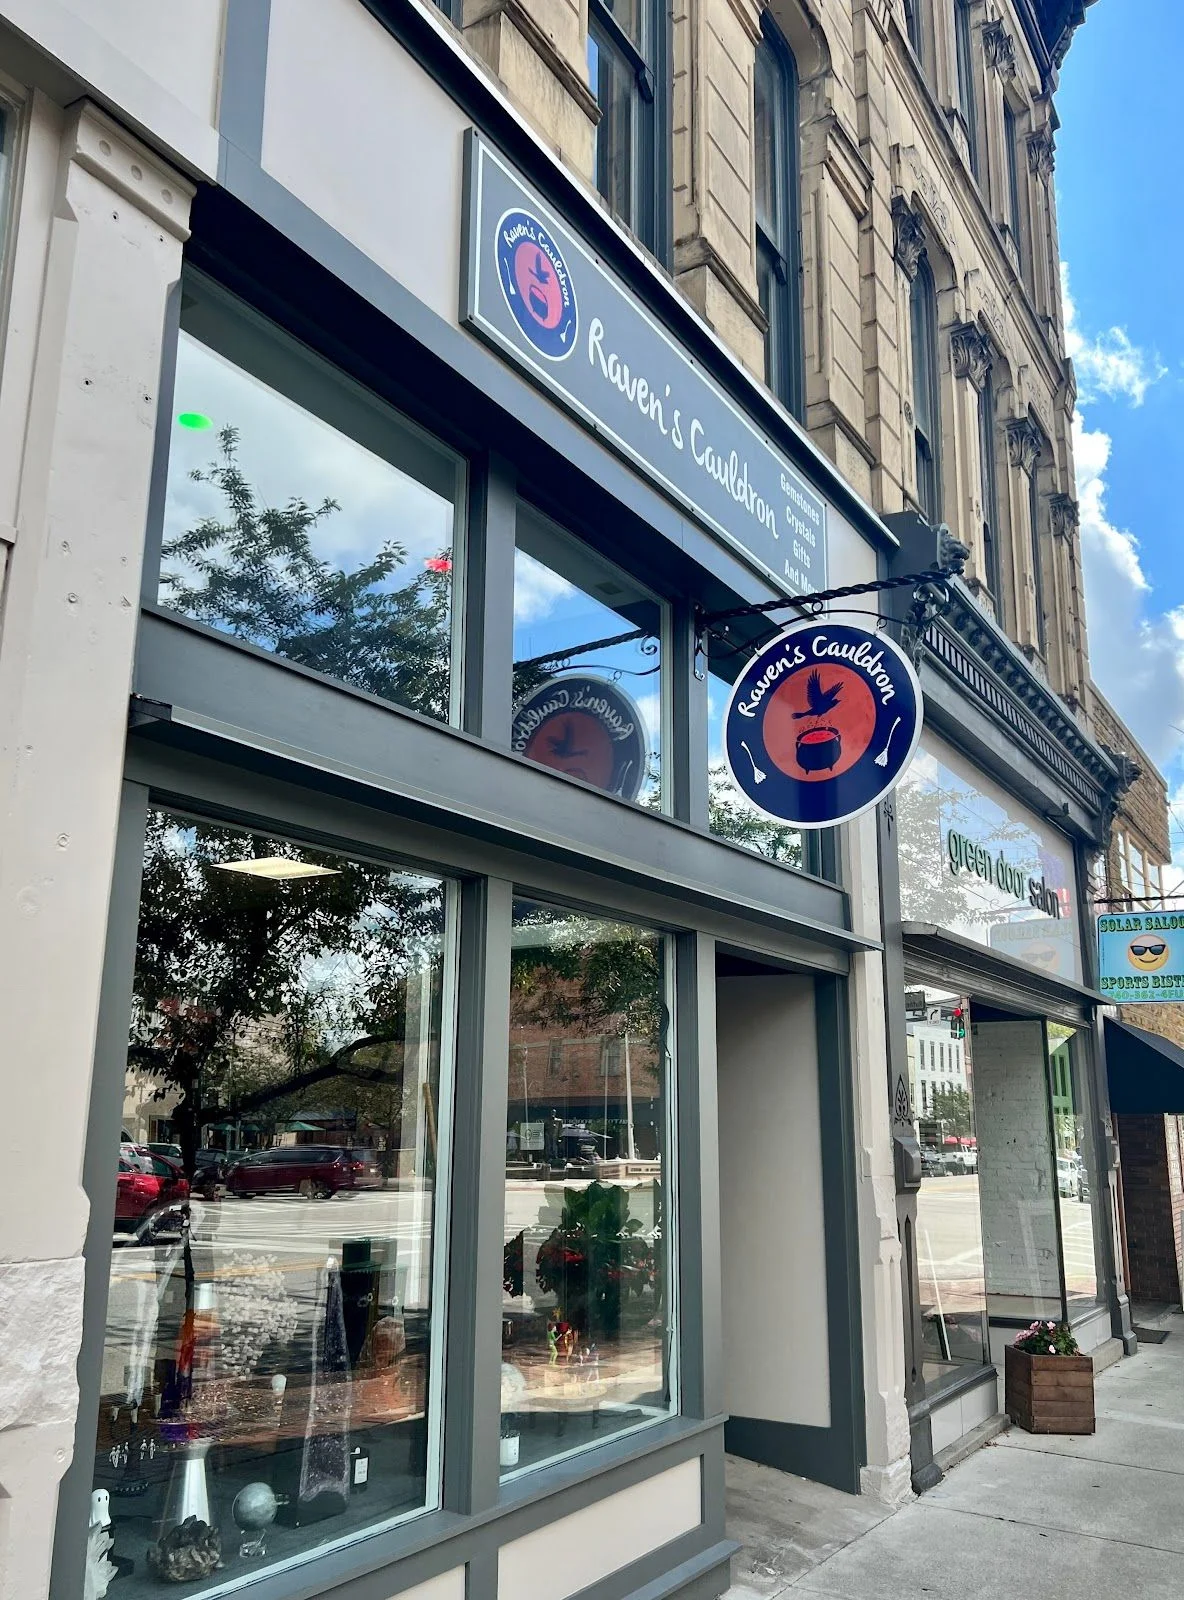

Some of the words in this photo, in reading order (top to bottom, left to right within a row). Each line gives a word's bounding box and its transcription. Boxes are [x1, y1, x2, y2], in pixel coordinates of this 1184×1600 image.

[503, 219, 536, 248] Raven's
[538, 231, 570, 308] Cauldron
[587, 317, 684, 450] Raven's
[690, 419, 779, 539] Cauldron
[780, 472, 820, 526] Gemstones
[785, 505, 816, 548] Crystals
[784, 559, 800, 586] And
[800, 572, 819, 595] Mor
[793, 539, 811, 569] Gifts
[737, 643, 806, 718] Raven's
[812, 635, 896, 705] Cauldron
[948, 829, 993, 884] green
[996, 850, 1026, 900] door
[1028, 877, 1060, 920] salon
[1100, 918, 1143, 932] SOLAR
[1100, 975, 1150, 989] SPORTS
[1151, 974, 1184, 988] BIST
